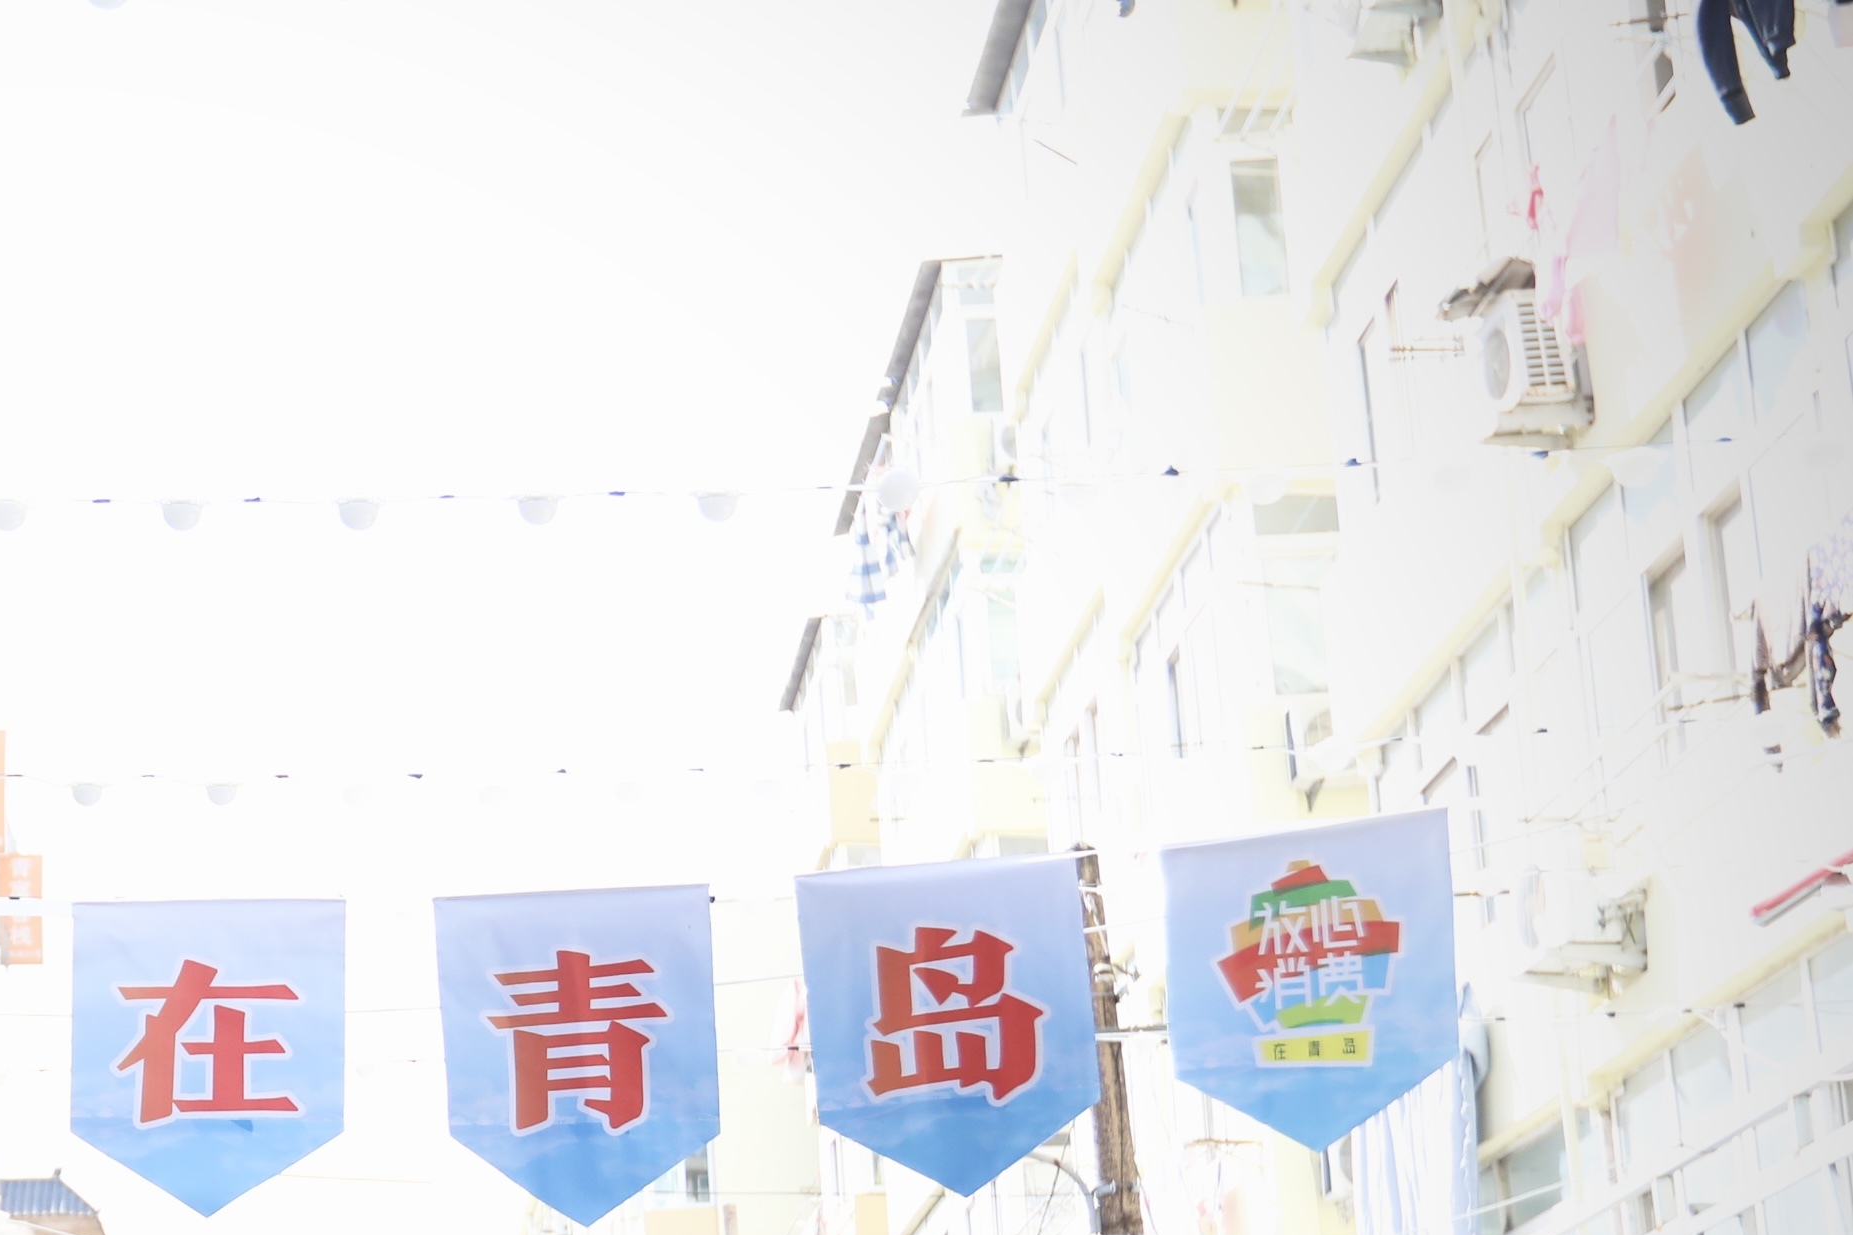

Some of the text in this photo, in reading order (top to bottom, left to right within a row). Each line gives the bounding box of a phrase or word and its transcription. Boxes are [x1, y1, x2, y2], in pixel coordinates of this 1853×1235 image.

[1254, 896, 1365, 955] 放心
[1254, 951, 1363, 1009] 消费
[116, 958, 300, 1124] 在
[487, 949, 668, 1130] 青
[866, 926, 1045, 1101] 岛
